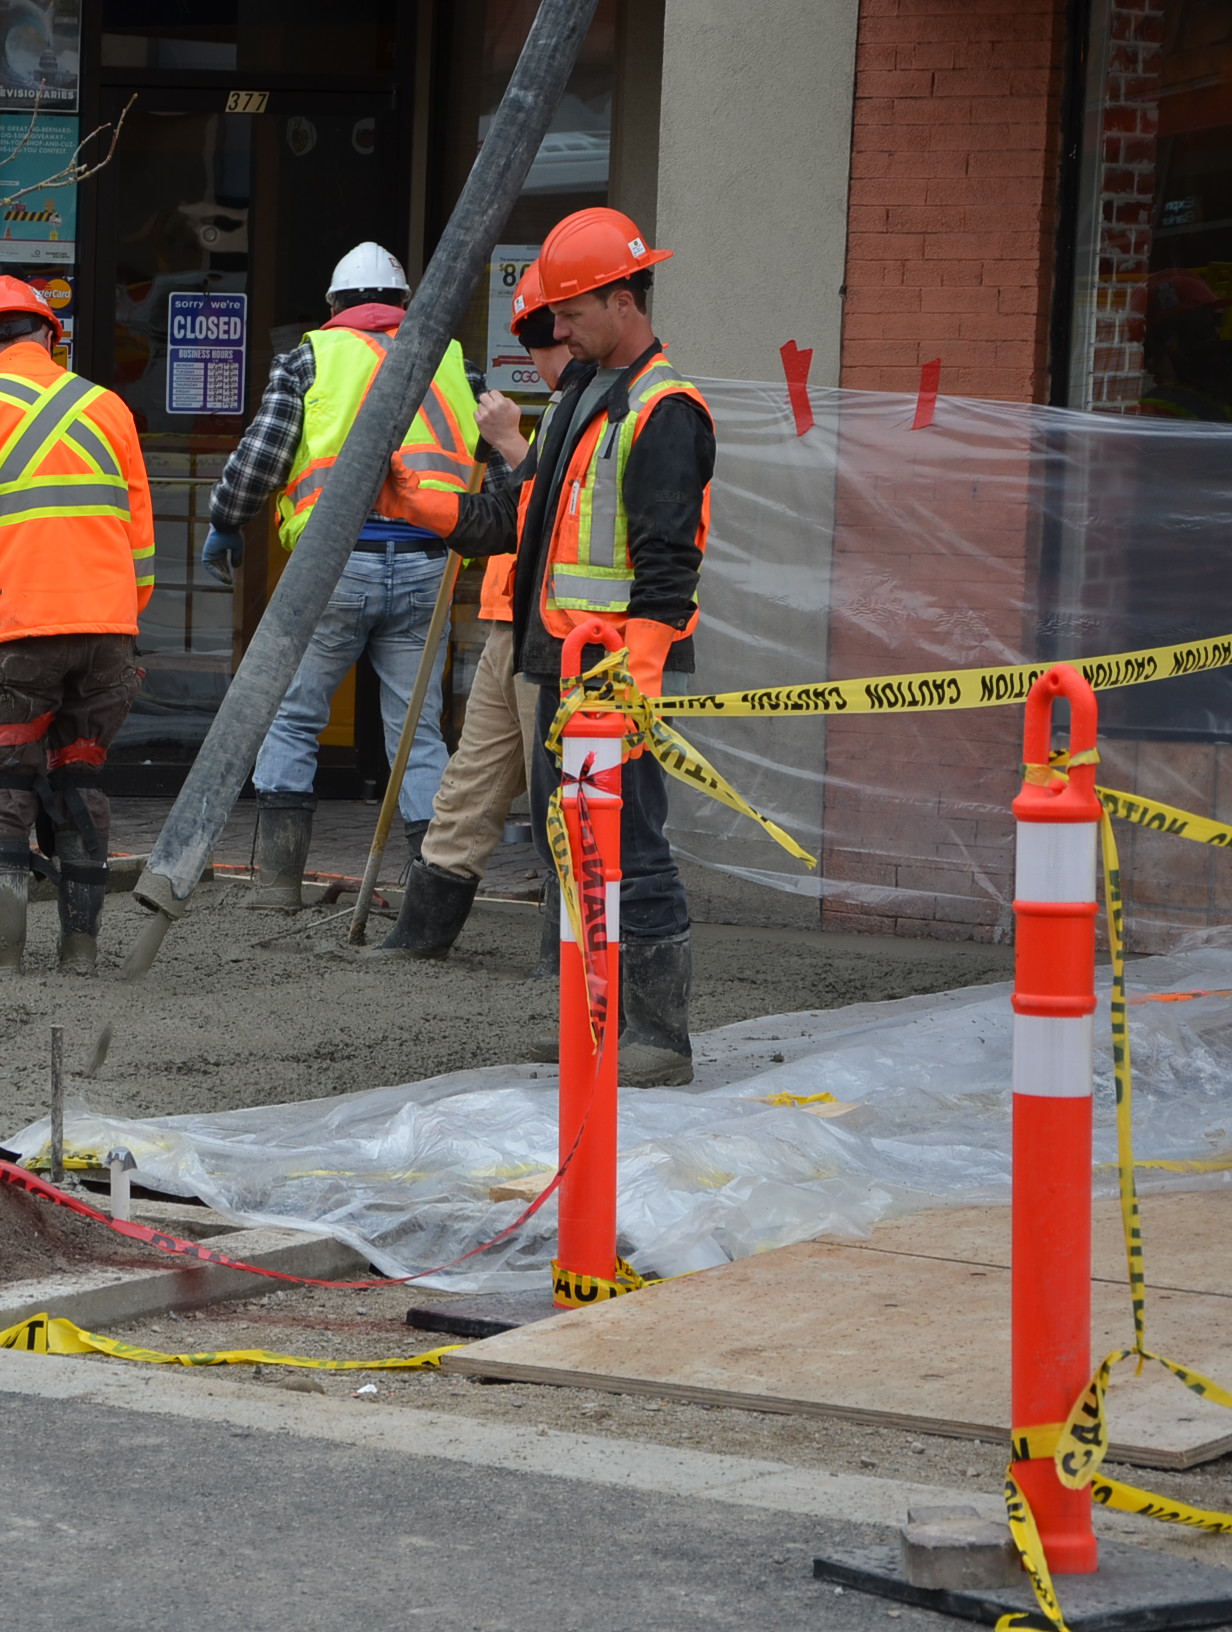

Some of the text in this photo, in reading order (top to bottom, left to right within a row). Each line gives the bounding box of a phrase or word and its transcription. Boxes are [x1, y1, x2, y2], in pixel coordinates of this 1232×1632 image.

[228, 92, 267, 112] 377
[175, 299, 241, 309] sorry we're
[173, 315, 241, 340] CLOSED
[178, 349, 234, 359] BUSINESS HOURS
[1082, 655, 1158, 690] CAUTION
[741, 686, 848, 711] CAUTION
[864, 676, 962, 709] CAUTION
